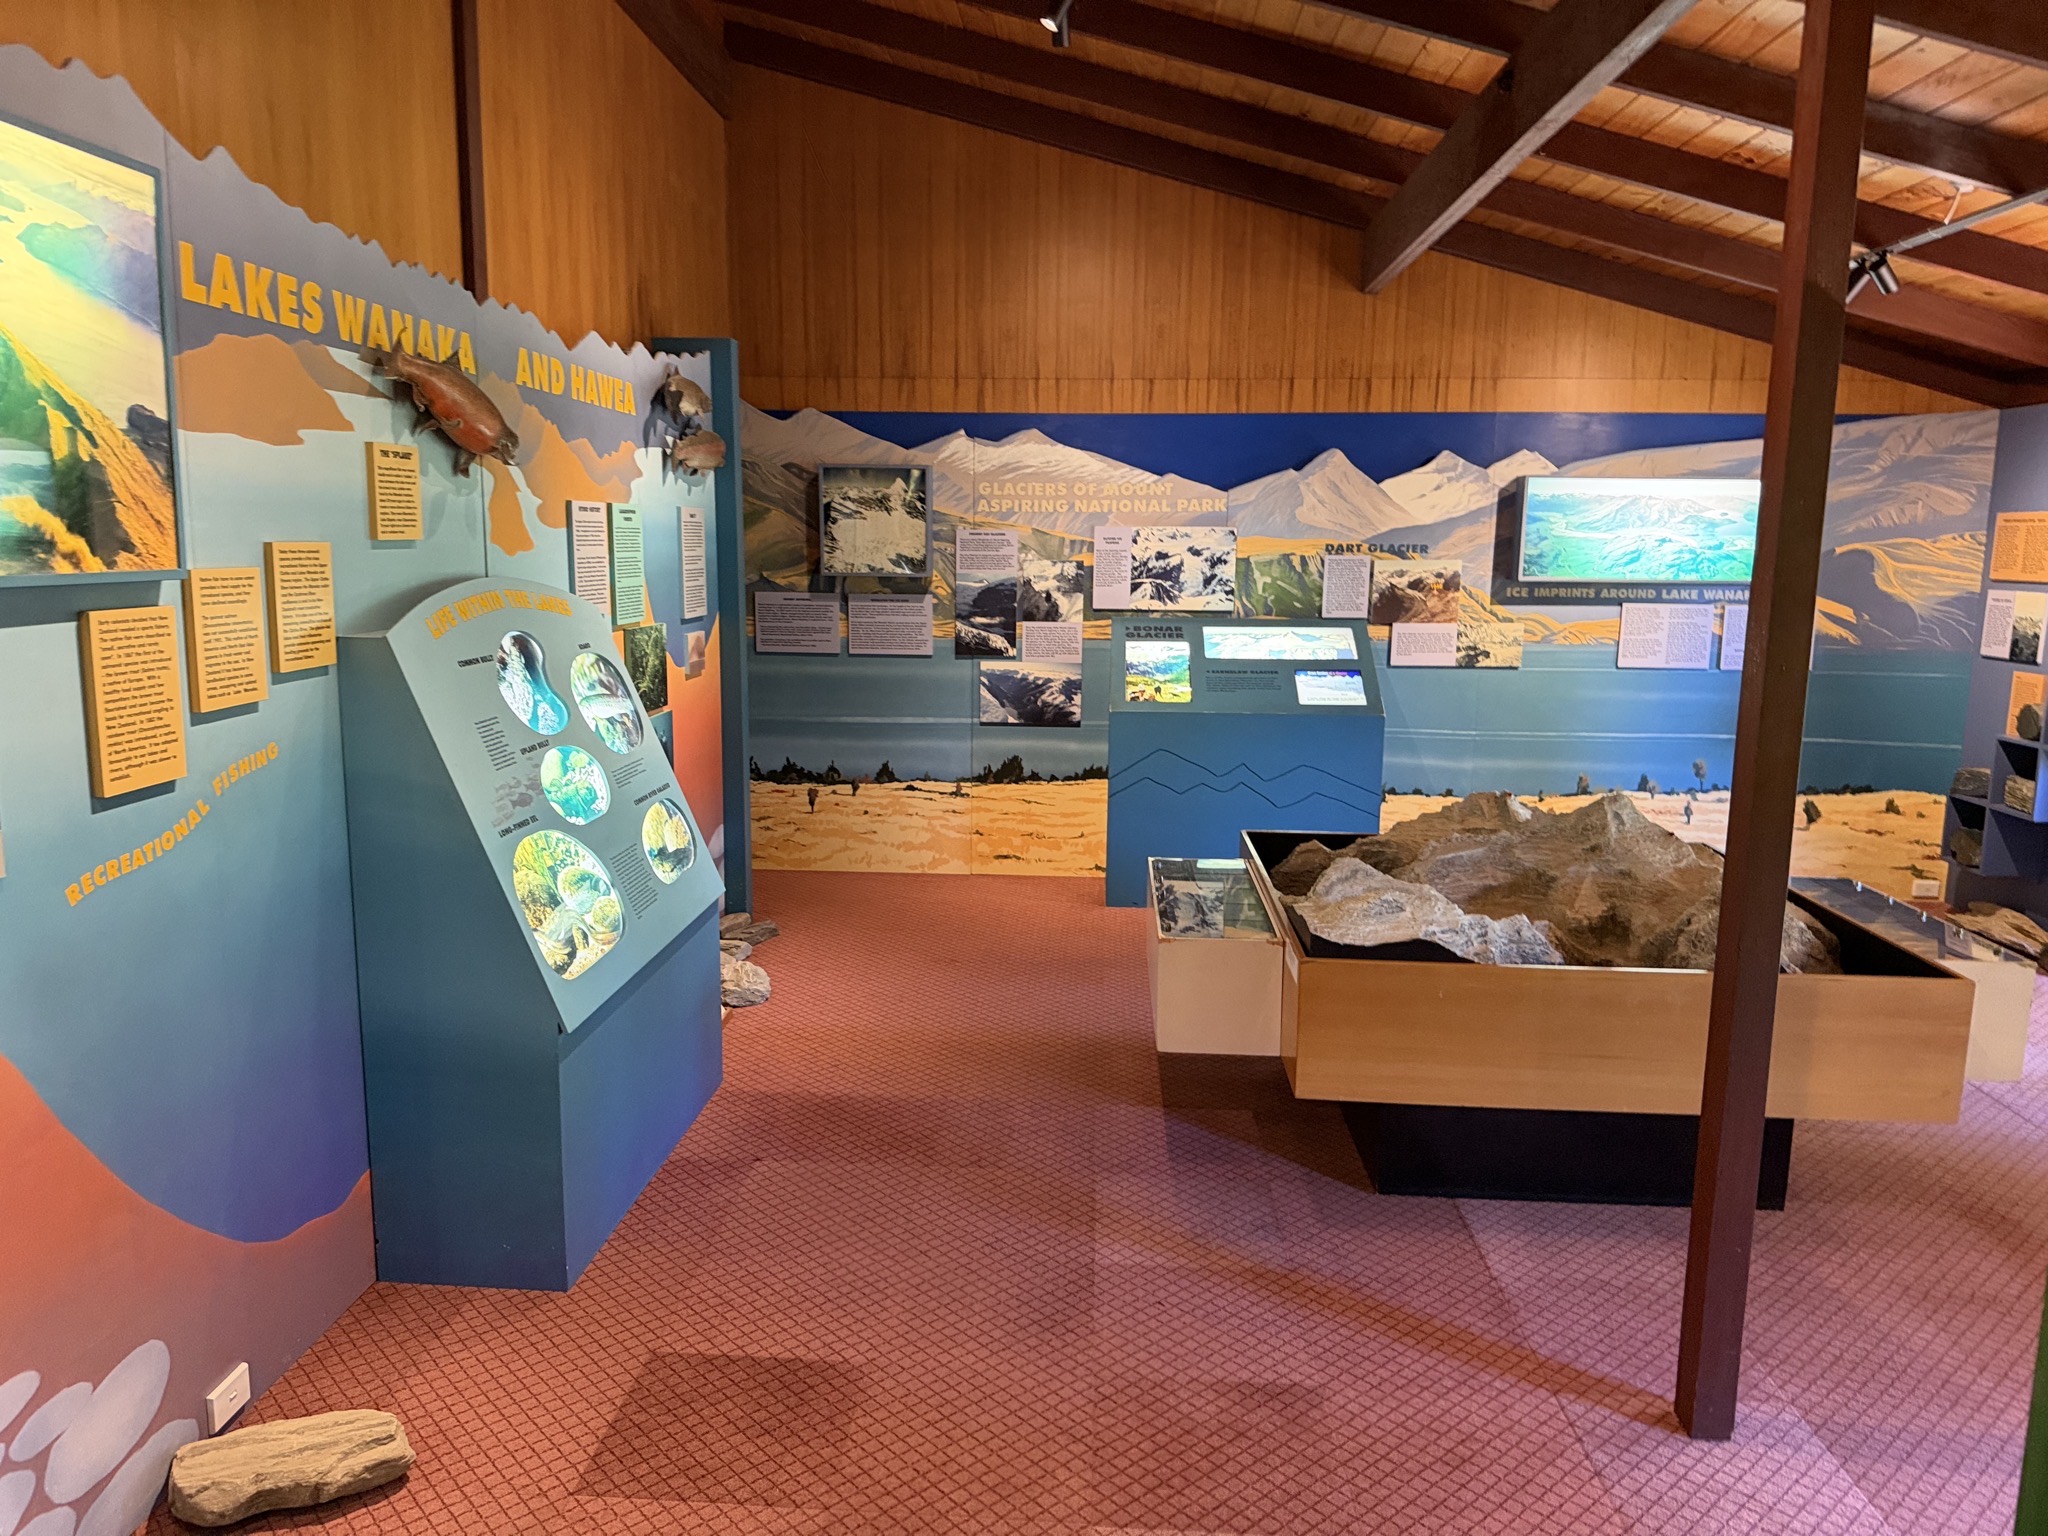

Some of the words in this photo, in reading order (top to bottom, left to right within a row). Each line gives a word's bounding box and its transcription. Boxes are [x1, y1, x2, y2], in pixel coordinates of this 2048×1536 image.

[179, 240, 323, 334] LAKES
[332, 289, 476, 375] WANAKA
[516, 346, 565, 395] AND
[570, 363, 636, 416] HAWEA
[978, 482, 1068, 496] GLACIERS
[1073, 482, 1098, 496] OF
[1101, 482, 1174, 496] MOUNT
[976, 499, 1069, 513] ASPIRING
[1074, 499, 1171, 513] NATIONAL
[1177, 498, 1228, 512] PARK
[1325, 543, 1363, 554] DART
[1367, 543, 1429, 554] GLACIER
[1506, 587, 1529, 598] ICE
[1534, 587, 1595, 599] IMPRINTS
[1600, 588, 1657, 599] AROUND
[1661, 589, 1699, 600] LAKE
[425, 604, 458, 640] LIFE
[453, 589, 506, 622] WITHIN
[503, 589, 533, 609] THE
[531, 591, 573, 617] LAKES
[64, 799, 210, 907] RECREATIONAL
[212, 741, 279, 796] FISHING
